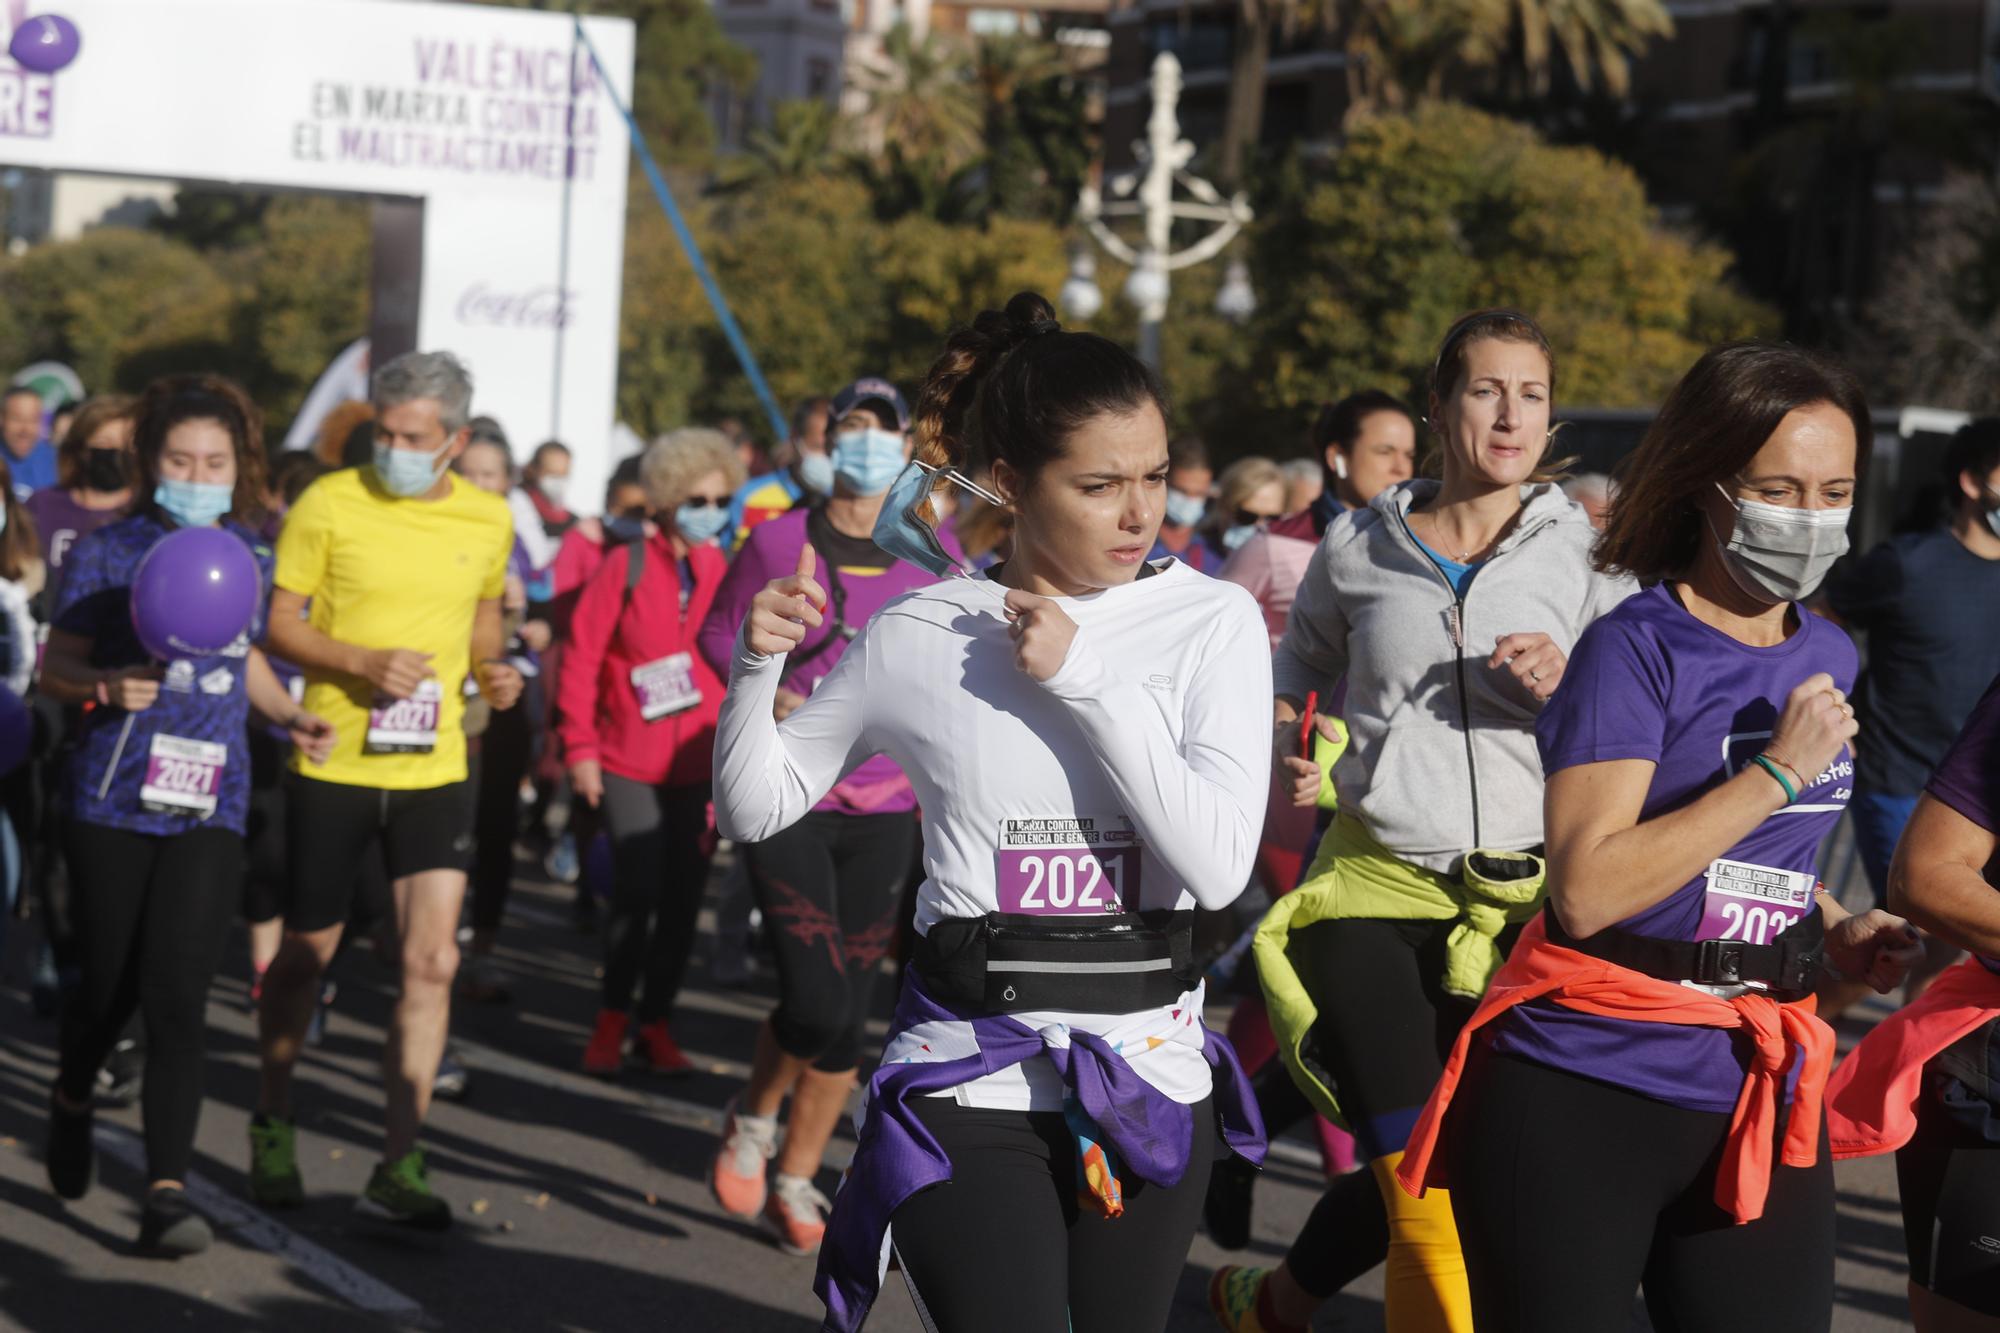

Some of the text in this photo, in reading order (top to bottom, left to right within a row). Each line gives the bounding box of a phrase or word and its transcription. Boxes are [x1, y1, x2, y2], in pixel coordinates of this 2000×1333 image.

[311, 80, 351, 120] EN
[482, 97, 598, 137] CONTA
[291, 119, 597, 181] EL MALTRACTAMET
[154, 758, 215, 793] 2021
[1047, 820, 1080, 831] CONTRA
[1081, 820, 1092, 830] LA
[1054, 832, 1065, 843] DE
[1019, 854, 1125, 909] 2021
